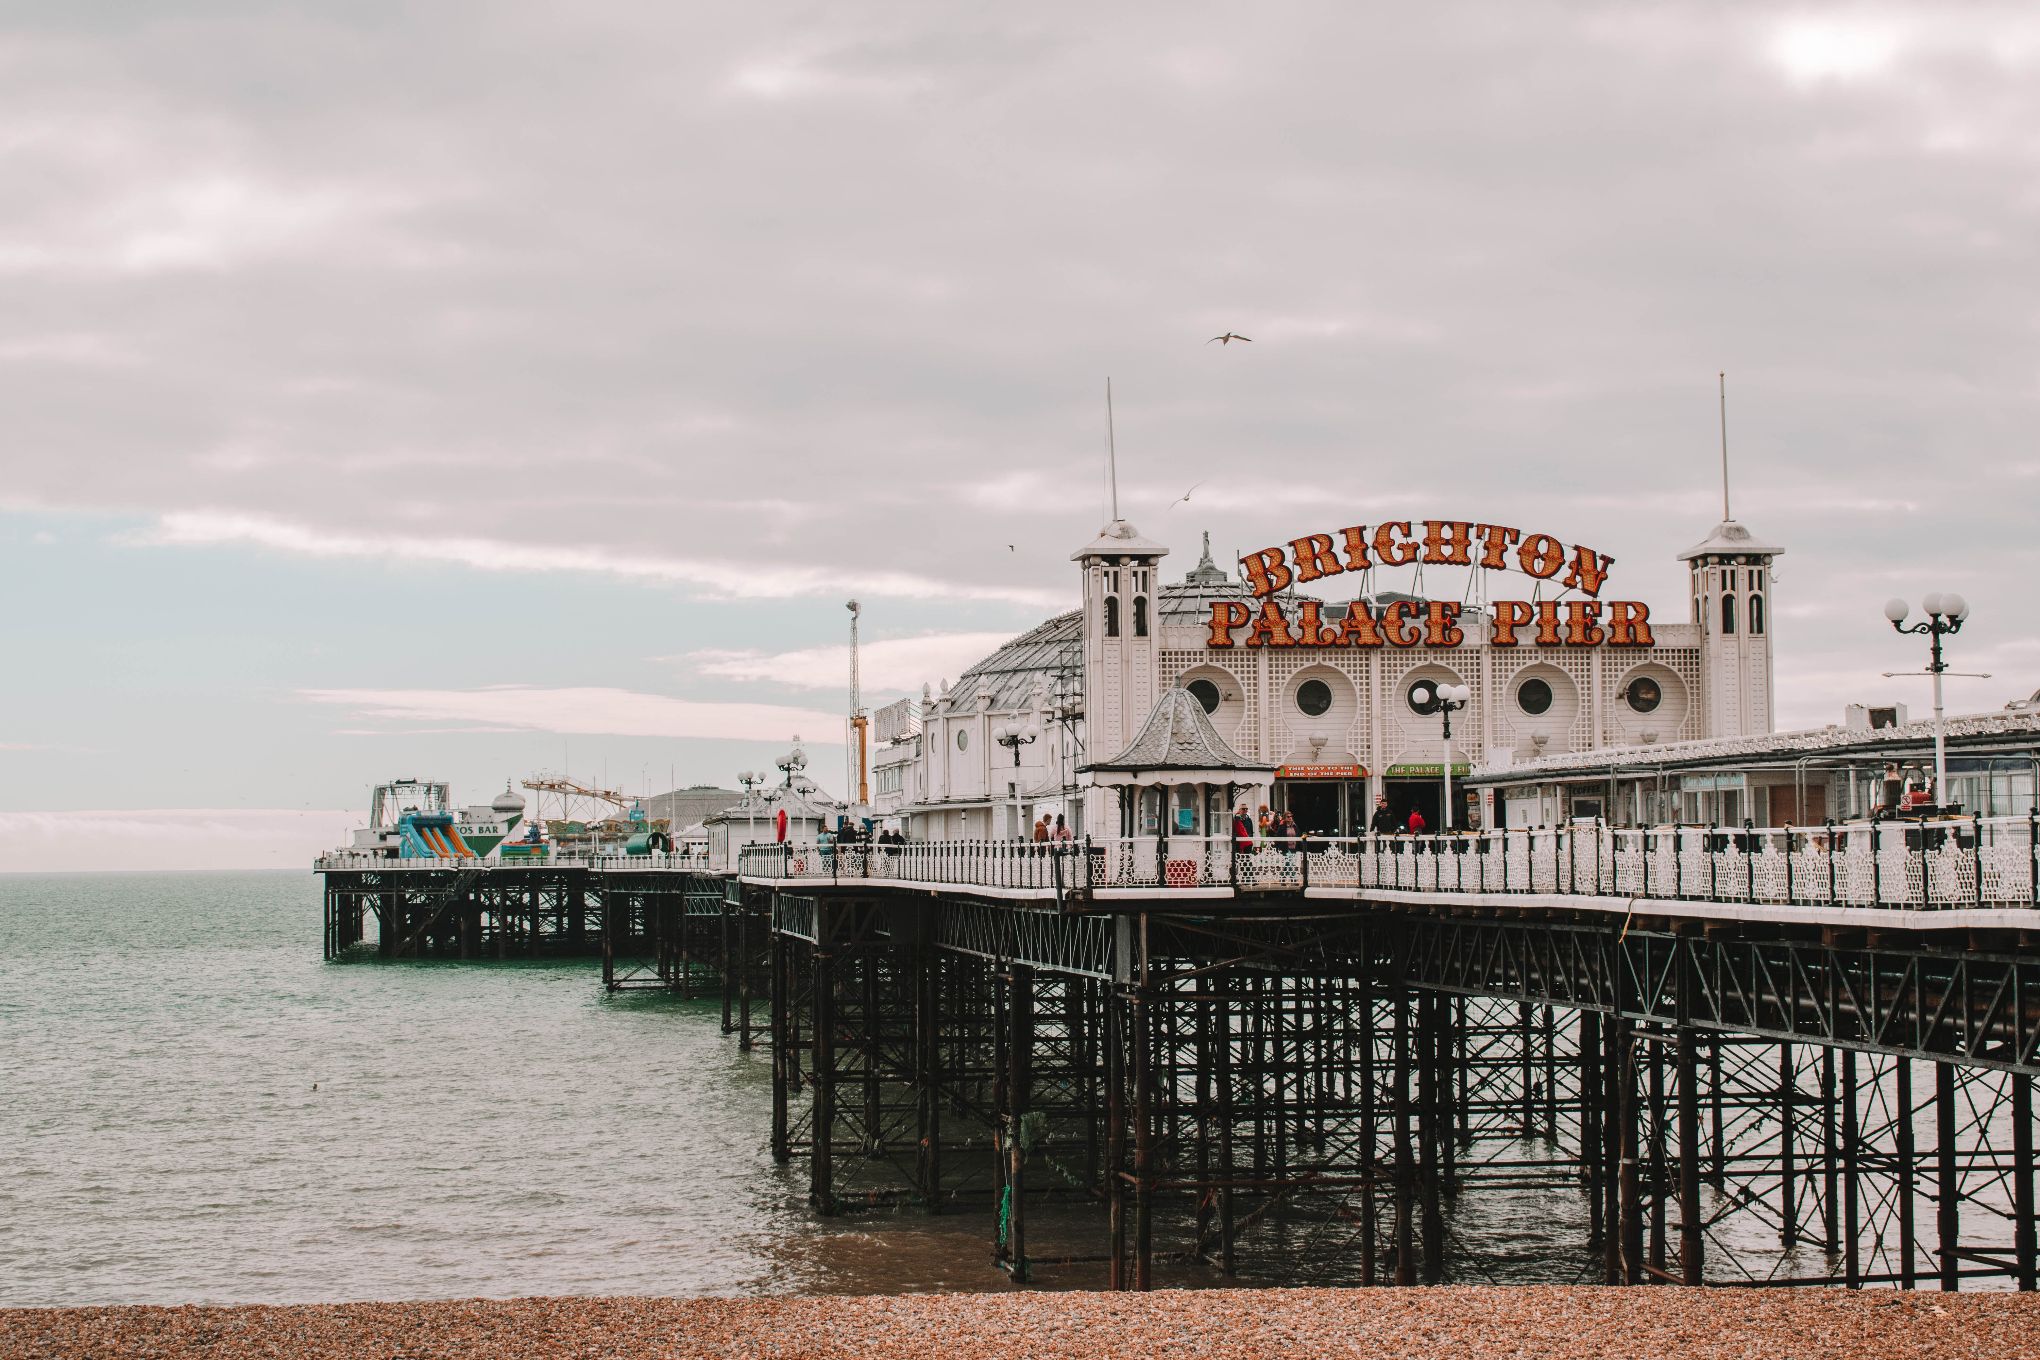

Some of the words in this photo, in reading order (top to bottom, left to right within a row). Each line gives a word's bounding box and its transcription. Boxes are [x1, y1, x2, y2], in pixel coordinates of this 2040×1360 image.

[1239, 520, 1615, 599] BRIGHTON
[1207, 600, 1465, 649] PALACE
[1489, 599, 1653, 647] PIER
[1391, 766, 1406, 775] THE
[1409, 766, 1440, 775] PALACE
[1572, 785, 1601, 795] COFFEE
[478, 826, 499, 835] BAR
